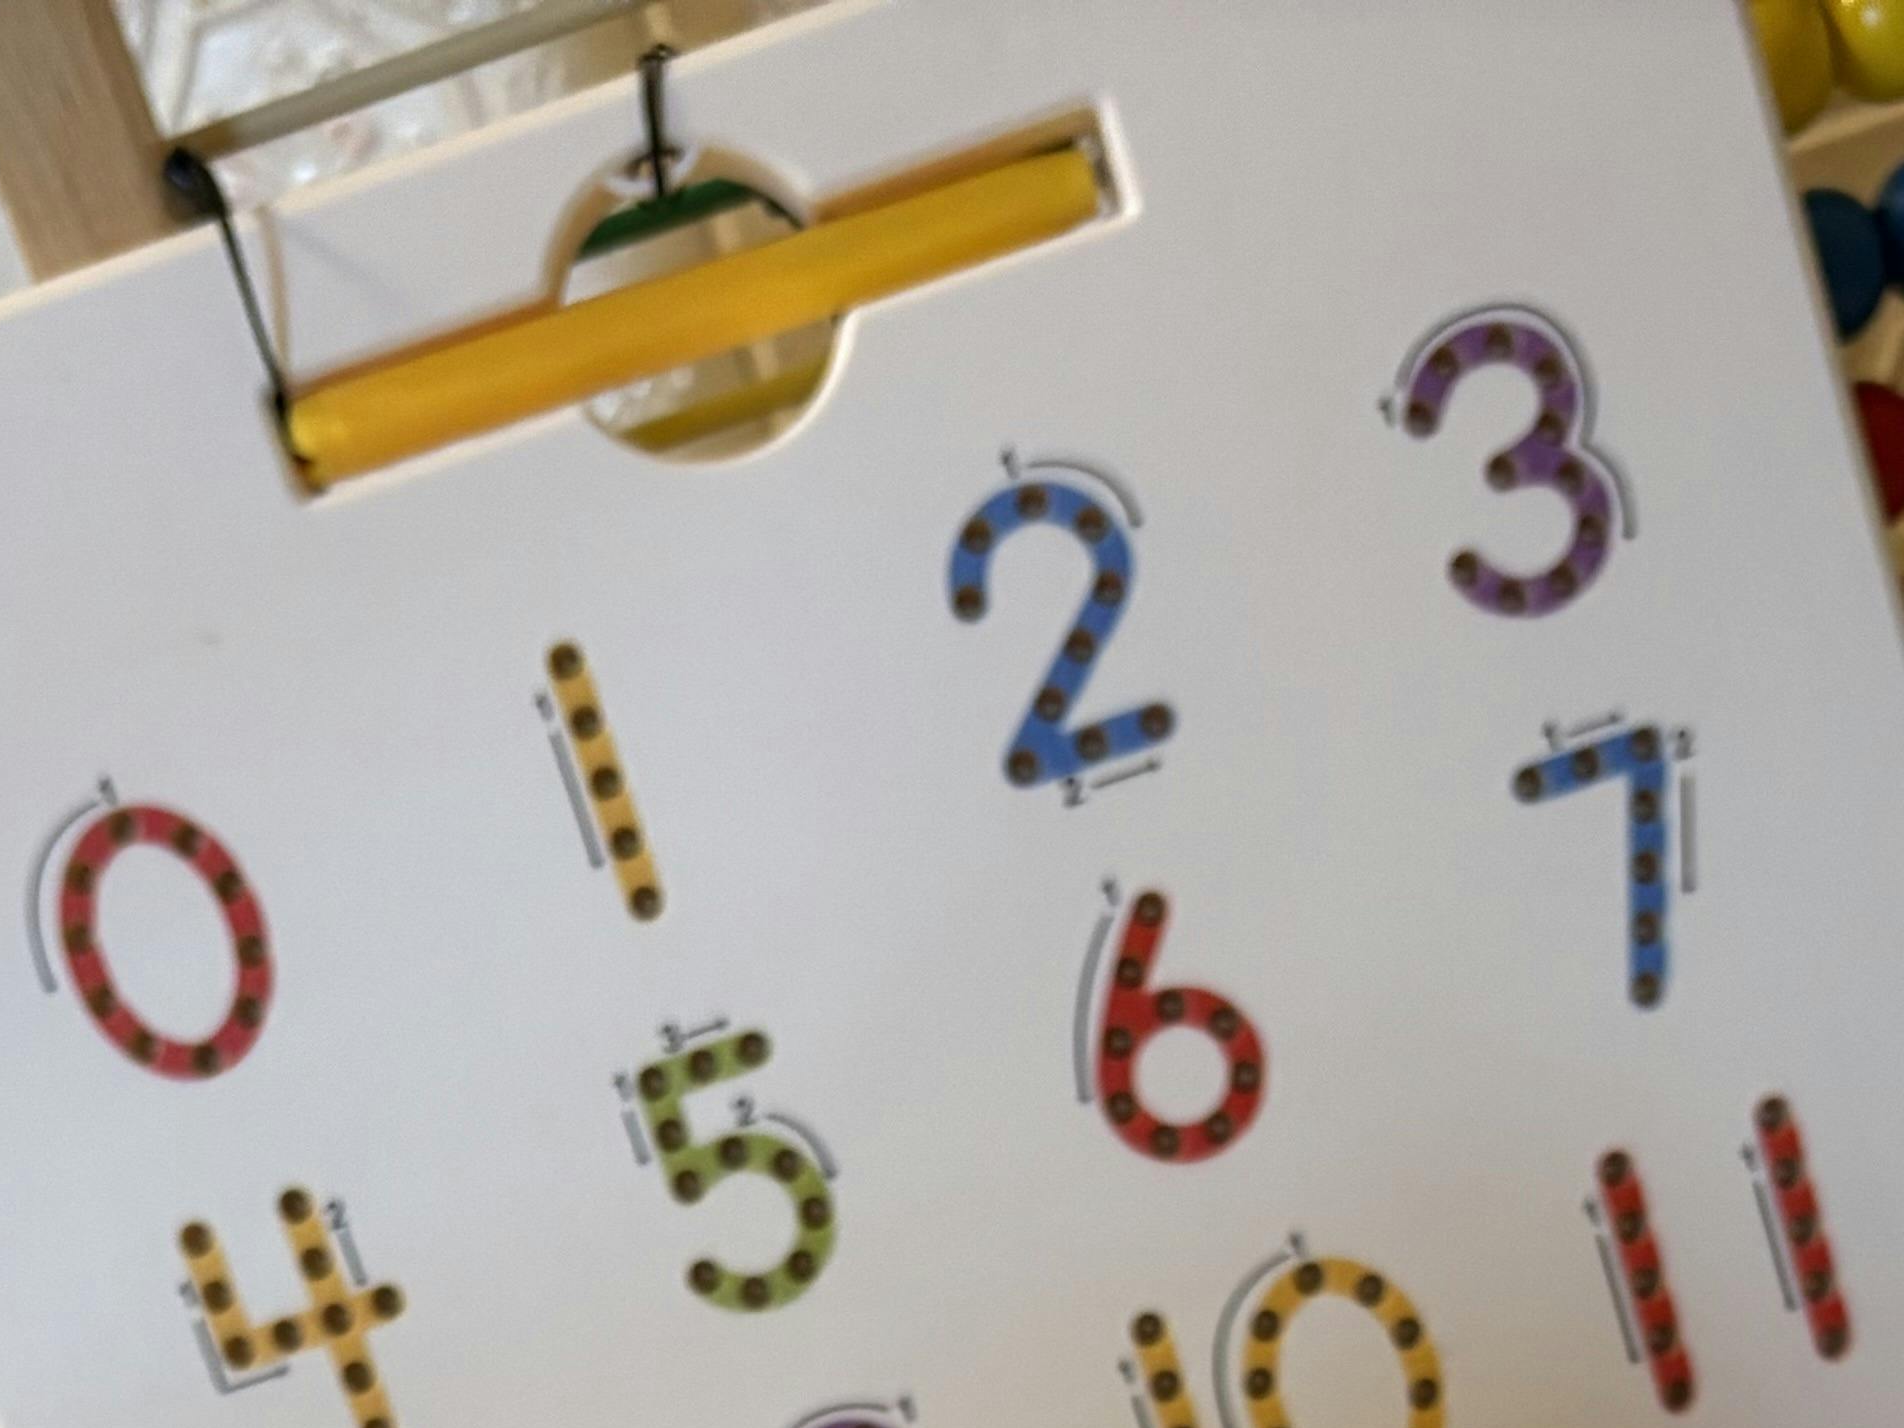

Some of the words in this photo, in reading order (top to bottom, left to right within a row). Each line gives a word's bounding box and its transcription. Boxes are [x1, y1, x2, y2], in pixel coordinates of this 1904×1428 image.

[1404, 320, 1613, 617] 3
[948, 481, 1175, 787] 2
[547, 640, 664, 922] 1
[1513, 724, 1666, 1010] 7
[57, 802, 274, 1081] 0
[1097, 891, 1266, 1164] 6
[637, 1031, 837, 1313] 5
[1597, 1092, 1852, 1415] 11
